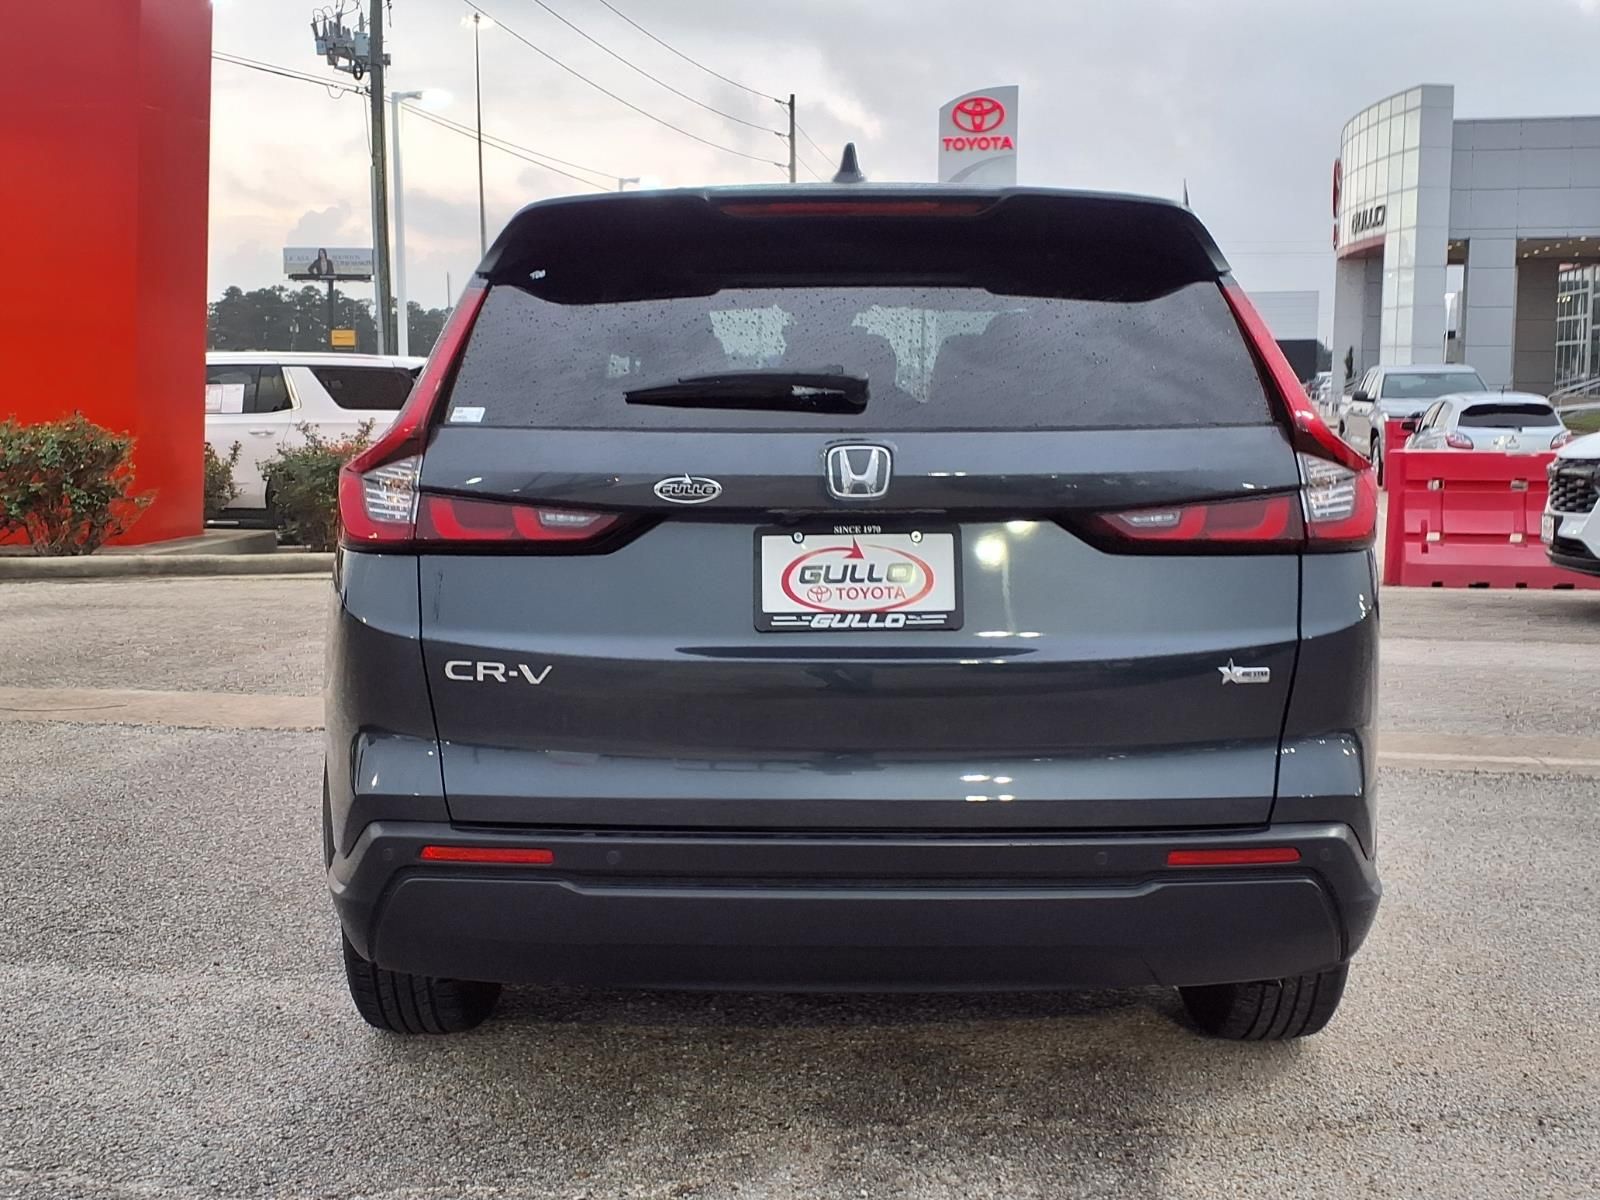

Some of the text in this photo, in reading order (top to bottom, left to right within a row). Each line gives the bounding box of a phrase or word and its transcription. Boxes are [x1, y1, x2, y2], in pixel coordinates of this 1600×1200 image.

[943, 136, 1013, 151] TOYOTA
[659, 483, 718, 497] GULLO
[833, 525, 861, 534] SINCE
[799, 562, 914, 584] GULLO
[835, 586, 907, 600] TOYOTA
[810, 613, 907, 628] GULLO
[444, 660, 553, 685] CR-V
